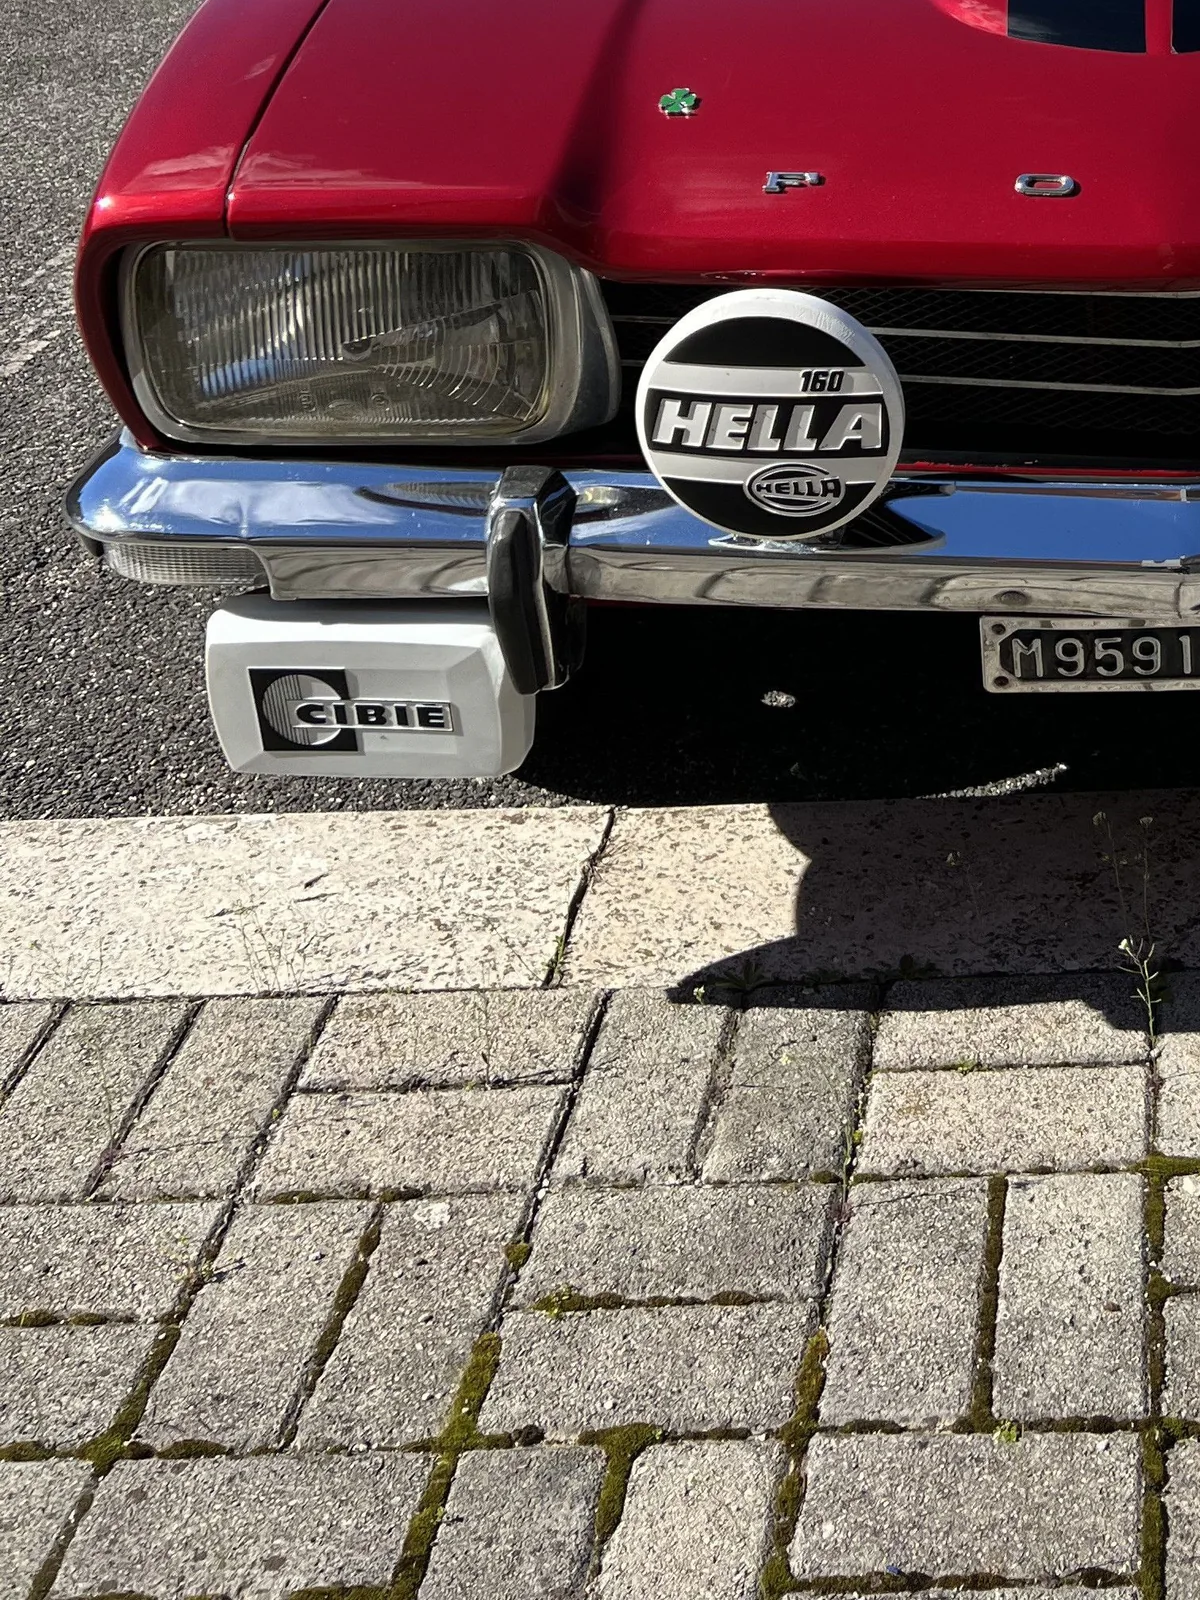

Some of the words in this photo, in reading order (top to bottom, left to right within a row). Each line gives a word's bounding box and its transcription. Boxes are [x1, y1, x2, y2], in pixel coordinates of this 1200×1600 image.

[801, 370, 845, 392] 160
[652, 399, 883, 450] HELLA
[755, 476, 842, 498] HELLA
